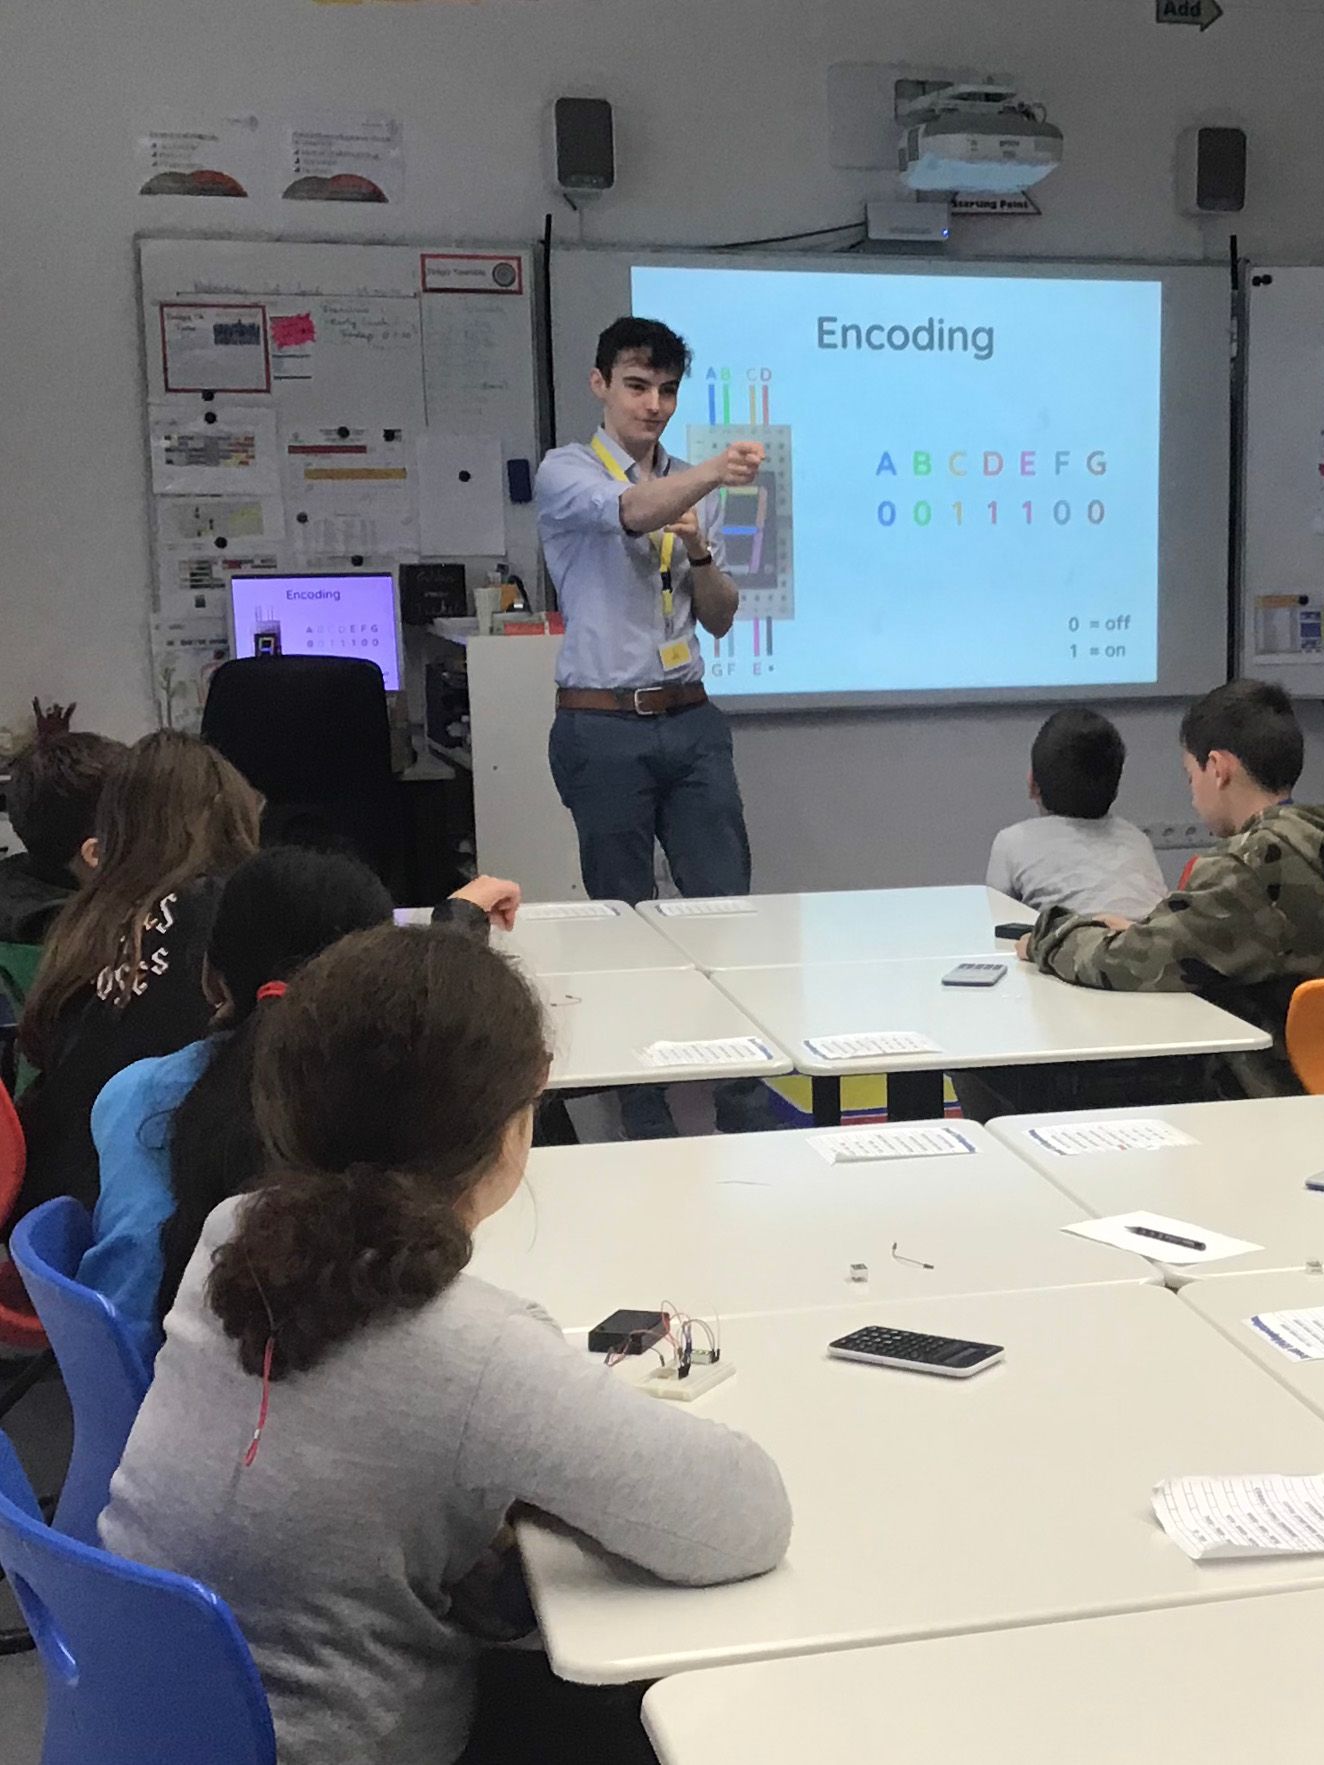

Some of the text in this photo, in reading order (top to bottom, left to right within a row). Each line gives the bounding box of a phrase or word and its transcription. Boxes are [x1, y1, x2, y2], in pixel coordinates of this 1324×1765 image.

[1163, 0, 1201, 17] Add
[1000, 199, 1028, 209] Point
[817, 316, 994, 361] Encoding
[705, 366, 717, 380] A
[746, 367, 758, 381] C
[760, 367, 772, 381] D
[876, 450, 1107, 476] A B C D E F G
[877, 499, 1105, 527] 0 0 1 1 1 0 0
[286, 589, 341, 601] Encoding
[351, 625, 357, 633] E
[371, 625, 379, 633] G
[1068, 616, 1079, 632] 0
[1105, 614, 1131, 631] off
[1069, 644, 1077, 658] 1
[1105, 645, 1126, 658] on
[711, 662, 762, 678] G F E
